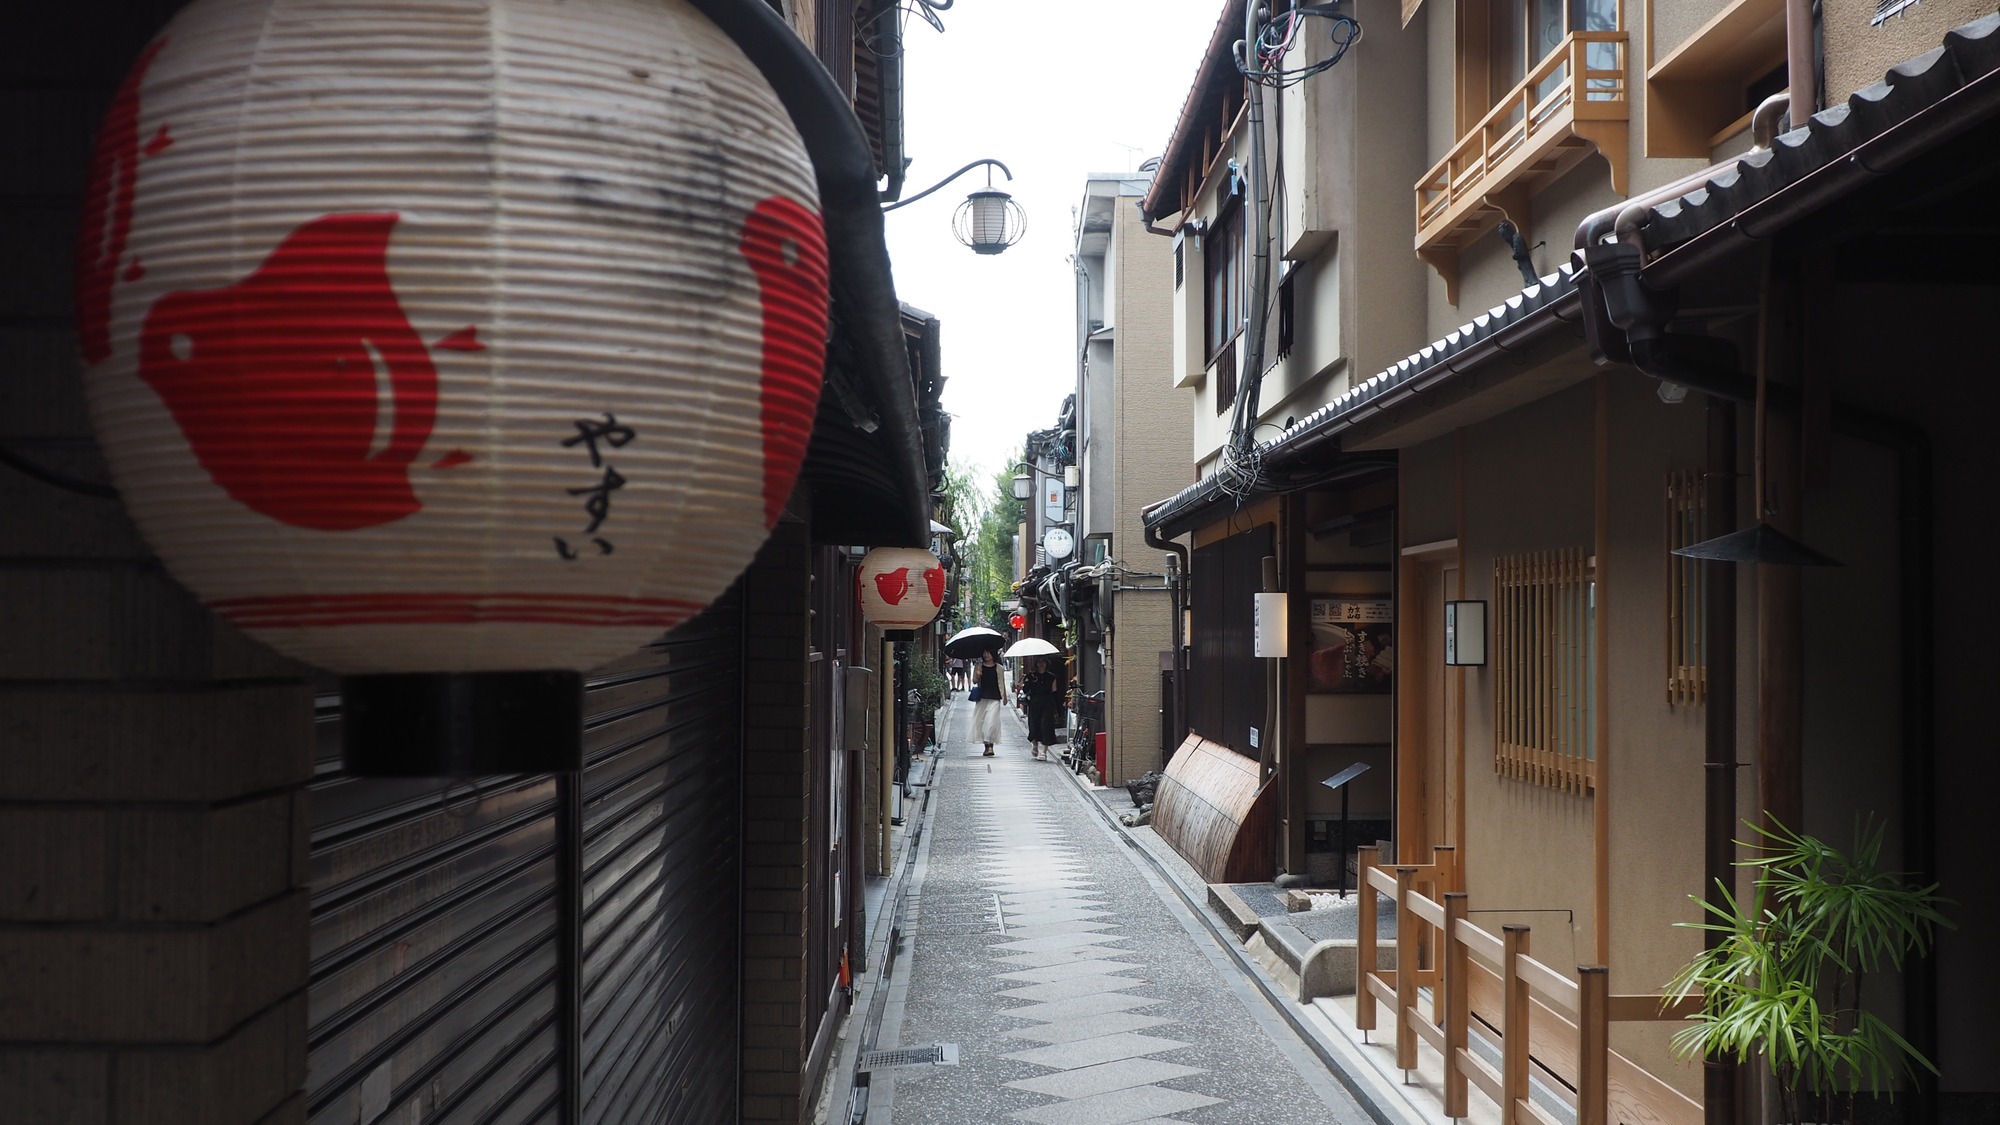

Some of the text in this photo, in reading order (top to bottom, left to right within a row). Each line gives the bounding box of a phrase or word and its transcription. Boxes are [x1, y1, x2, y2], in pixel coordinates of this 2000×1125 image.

[553, 412, 636, 560] やすい
[1342, 628, 1353, 679] しゃぶしゃぶ
[1355, 630, 1369, 679] すき焼き
